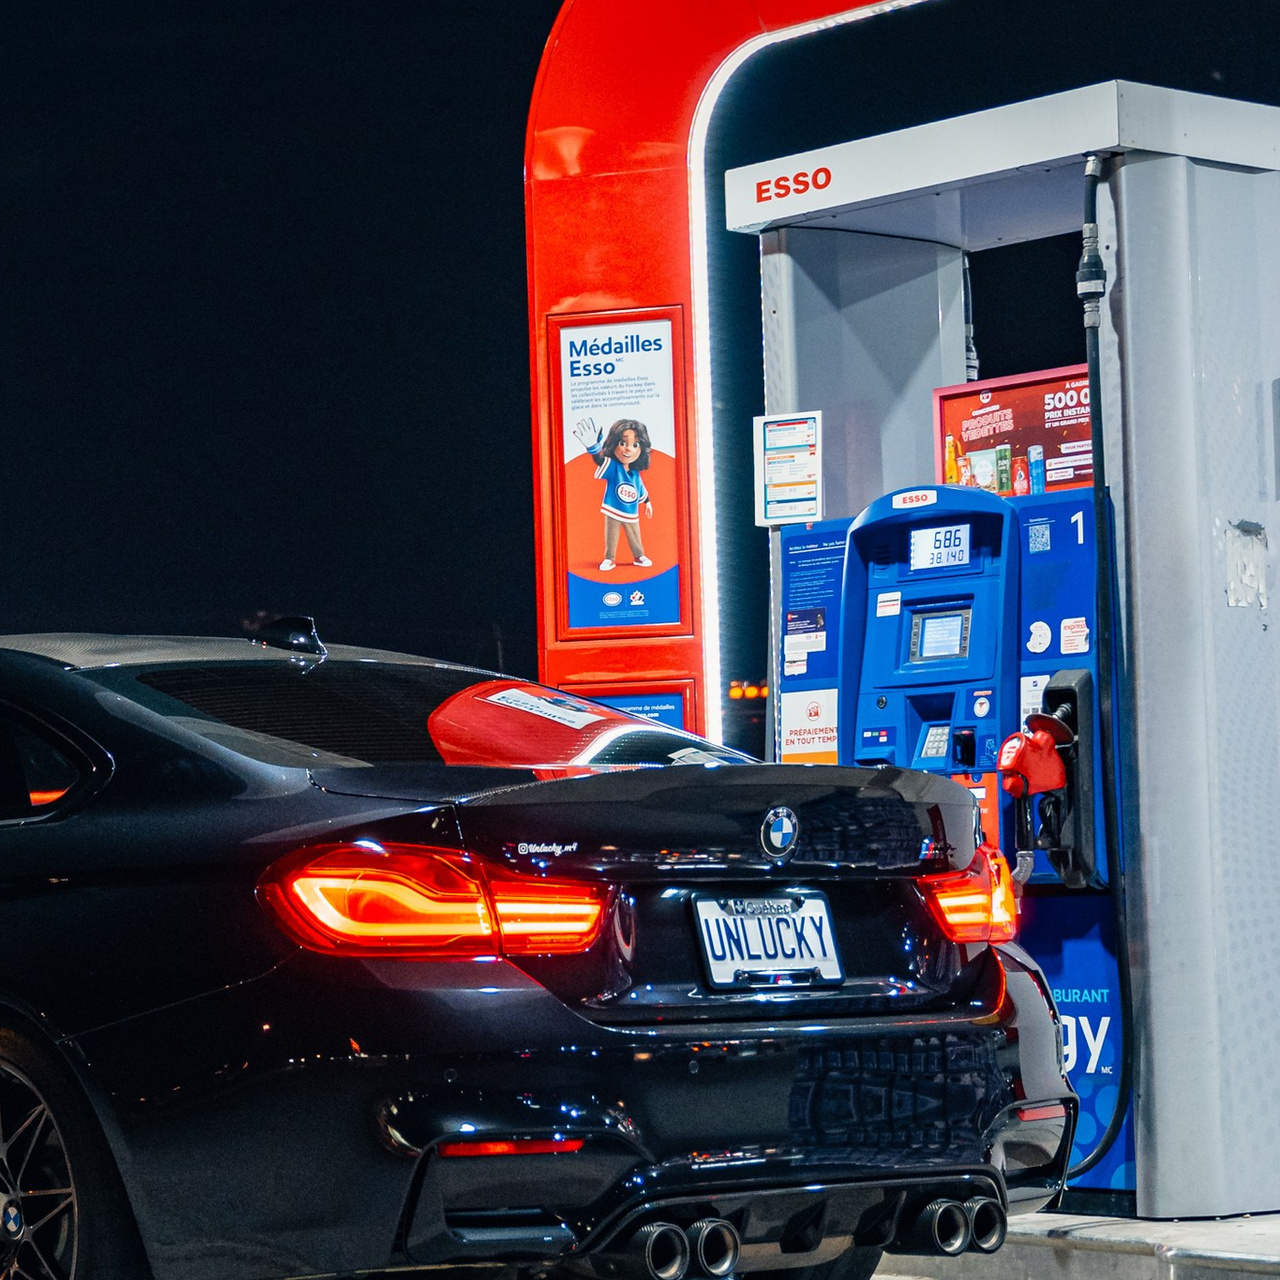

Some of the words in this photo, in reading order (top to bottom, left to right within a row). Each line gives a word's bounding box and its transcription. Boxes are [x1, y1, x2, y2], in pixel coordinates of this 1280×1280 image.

[754, 166, 832, 204] ESSO
[569, 334, 663, 358] Médailles
[569, 360, 616, 378] Esso
[961, 408, 1013, 431] PRODUITS
[1044, 409, 1063, 420] PRIX
[961, 419, 1014, 442] VEDETTES
[902, 494, 928, 504] ESSO
[1070, 510, 1084, 545] 1
[785, 738, 795, 746] EN
[797, 737, 815, 745] TOUT
[704, 915, 828, 961] UNLUCKY
[1101, 1066, 1113, 1074] MC
